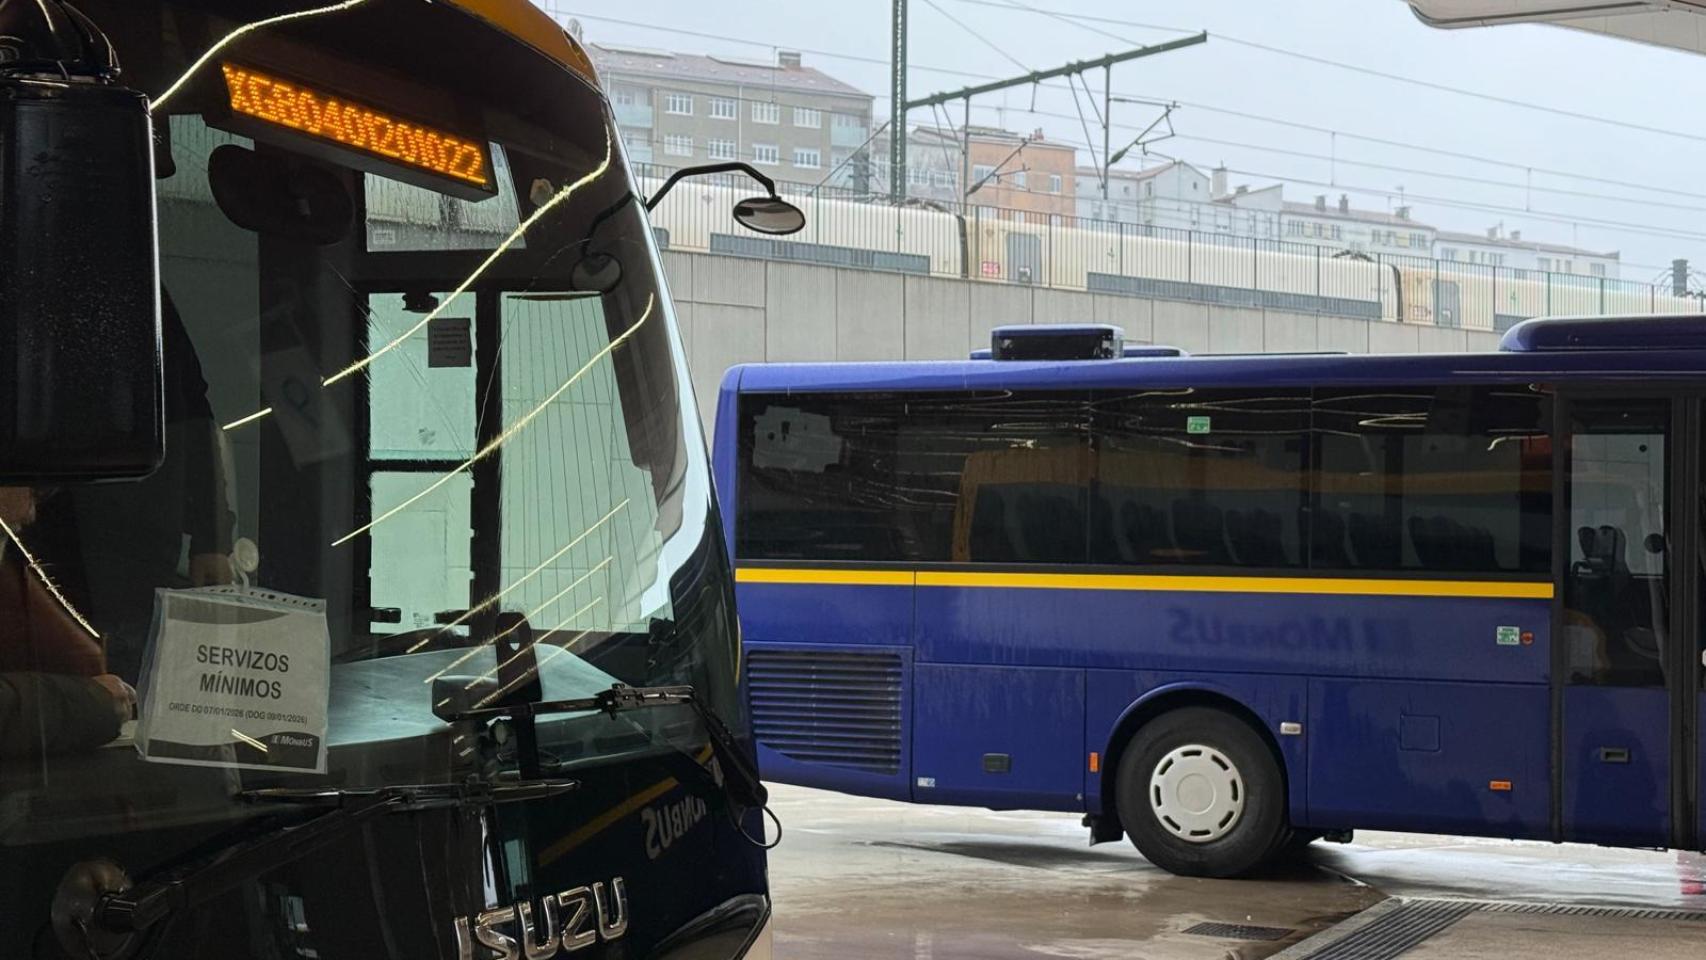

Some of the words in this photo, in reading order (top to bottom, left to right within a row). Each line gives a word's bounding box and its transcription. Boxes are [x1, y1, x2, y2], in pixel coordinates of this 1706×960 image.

[196, 644, 290, 673] SERVIZOS
[199, 670, 282, 700] MÍNIMOS
[169, 702, 191, 712] ORDE
[454, 876, 628, 960] ISUZU
